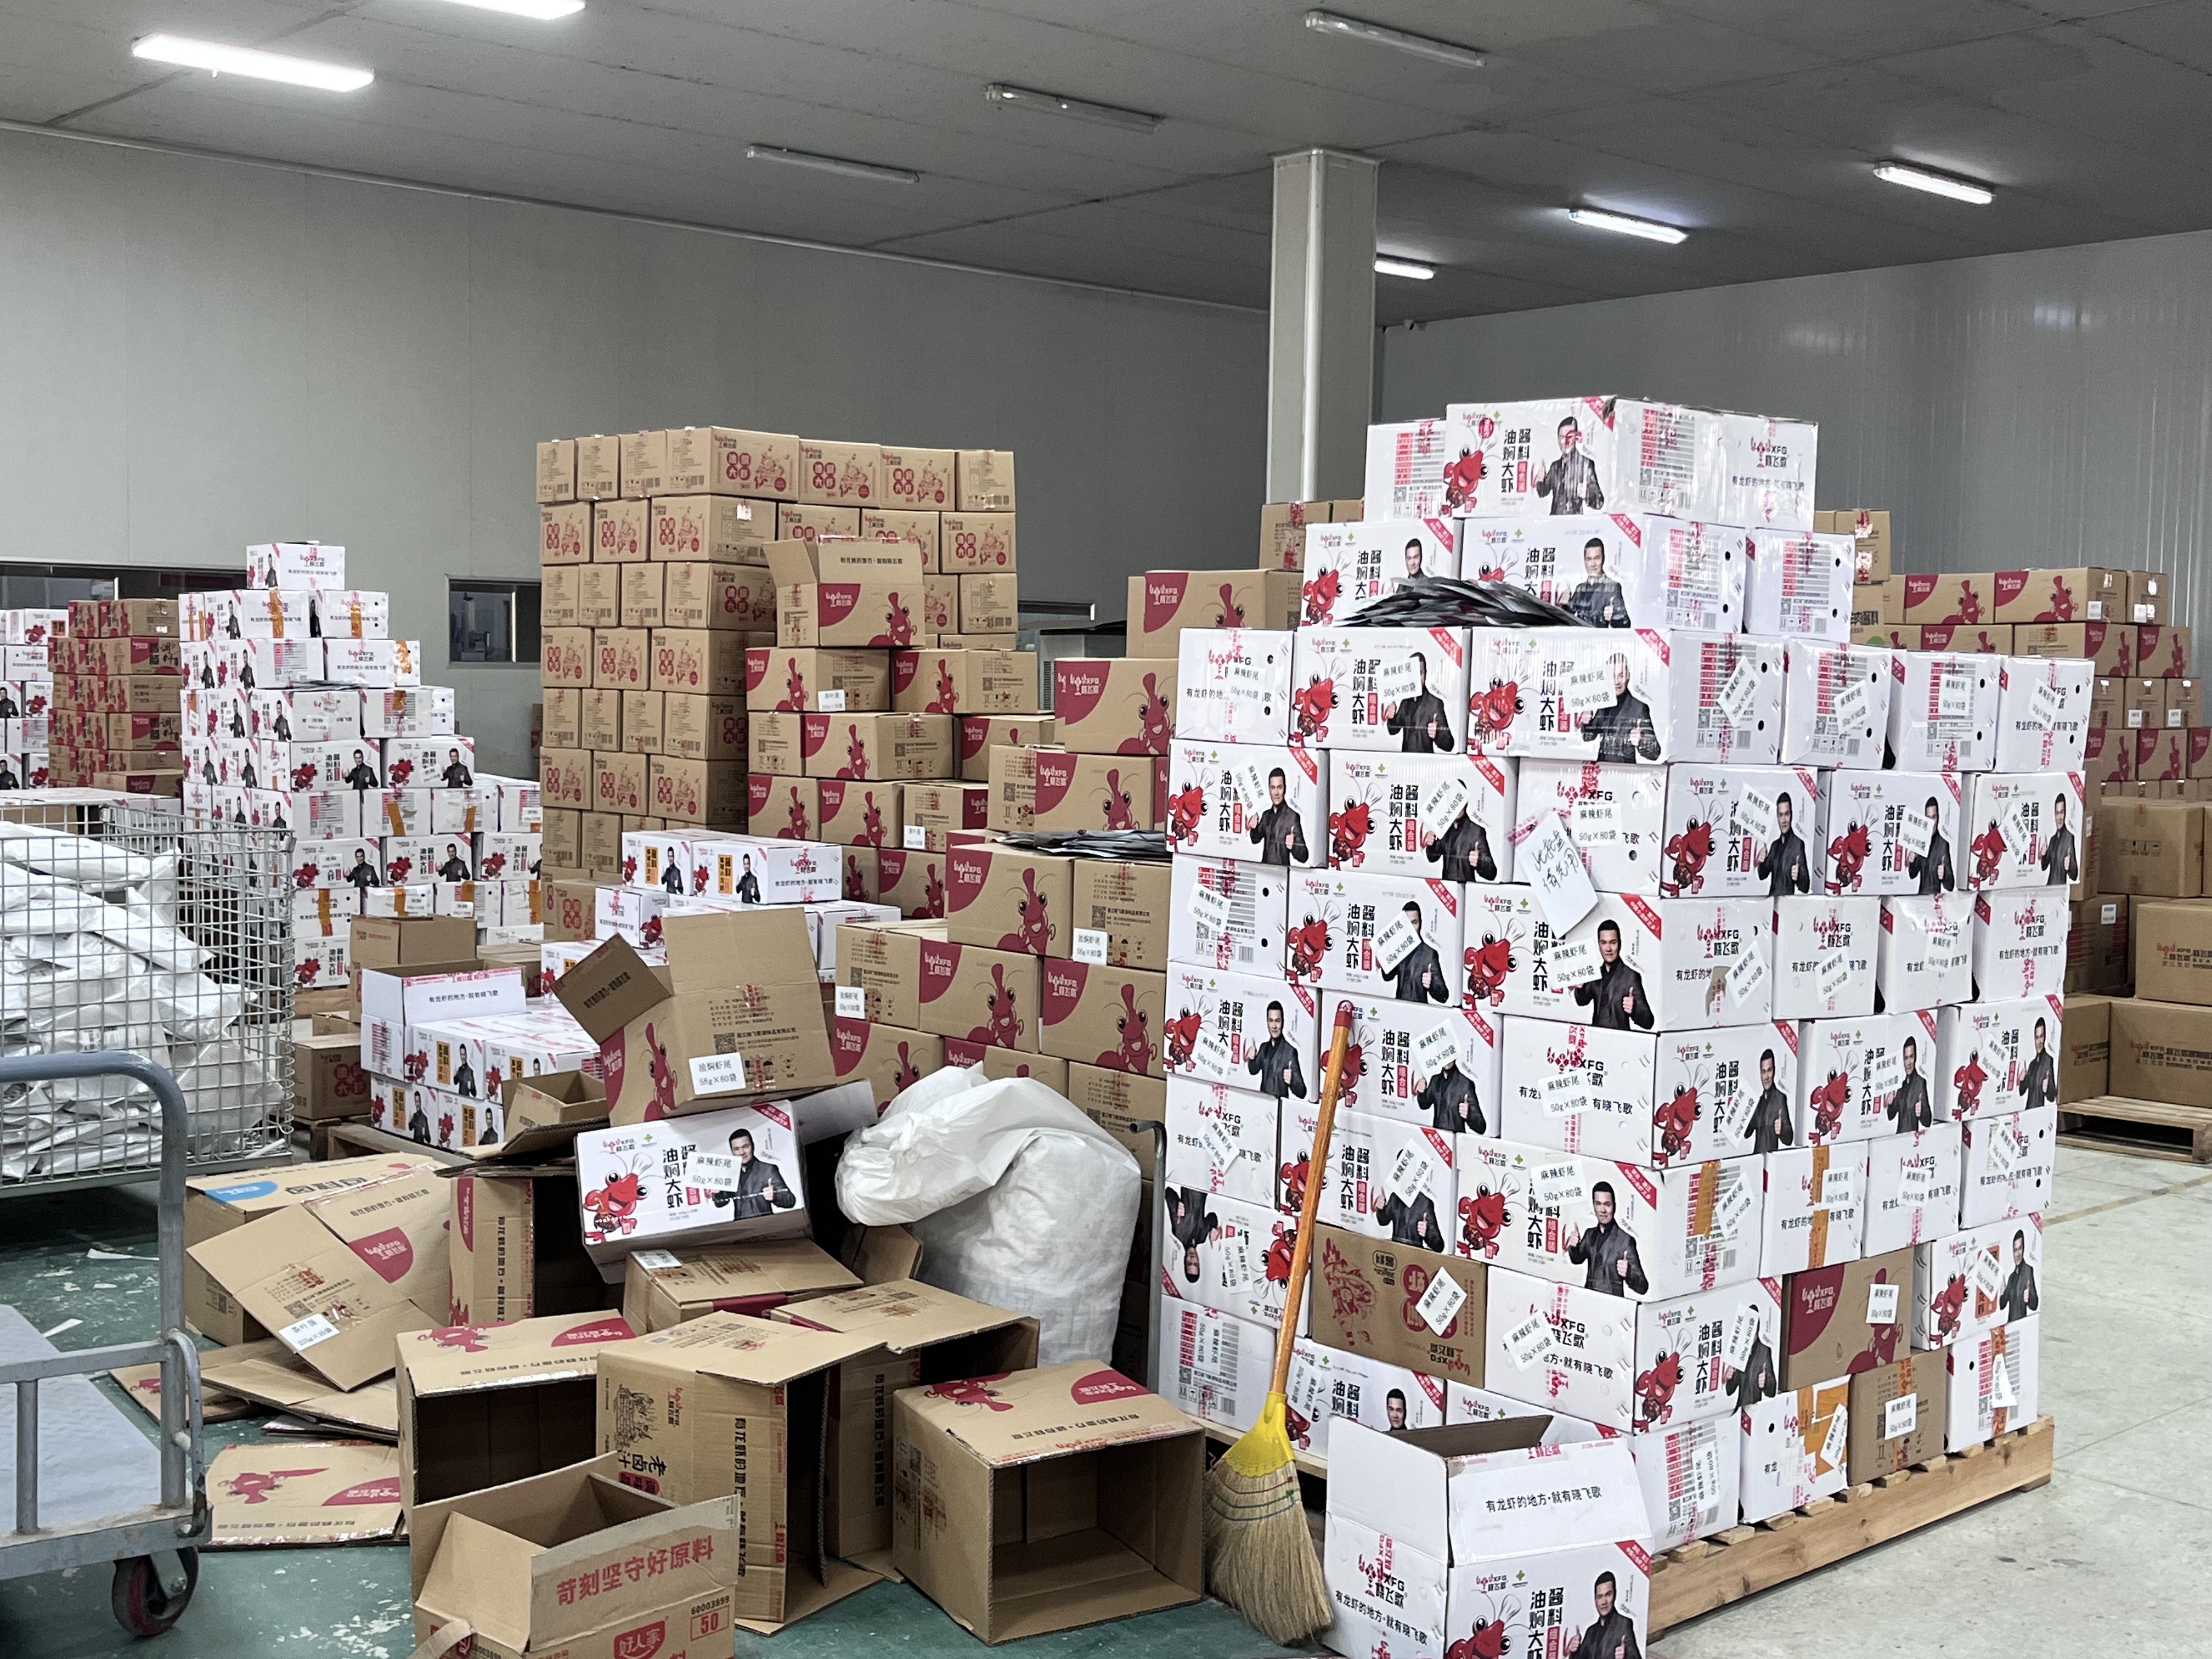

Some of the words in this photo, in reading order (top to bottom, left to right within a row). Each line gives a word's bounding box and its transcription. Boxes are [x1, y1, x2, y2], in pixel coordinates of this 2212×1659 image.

[1502, 428, 1515, 493] 油焖大虾
[1355, 551, 1368, 601] 油焖大
[1525, 548, 1539, 596] 油焖大
[1352, 658, 1366, 724] 油焖大虾
[1220, 770, 1232, 832] 油焖大虾
[1389, 784, 1402, 850] 油焖大虾
[1405, 785, 1419, 818] 酱料
[1346, 904, 1360, 969] 油焖大虾
[1362, 905, 1375, 938] 酱料
[1533, 921, 1549, 992] 油焖大虾
[1218, 1000, 1230, 1047] 油焖大
[1231, 1002, 1243, 1033] 酱料
[1381, 1029, 1395, 1096] 油焖大虾
[1397, 1031, 1410, 1065] 酱料
[1222, 1112, 1241, 1124] XFG
[662, 1148, 684, 1209] 油焖大虾
[1341, 1144, 1355, 1210] 油焖大虾
[1356, 1147, 1370, 1181] 酱料
[1527, 1178, 1543, 1250] 焖大虾
[1695, 1324, 1710, 1395] 油焖大虾
[1711, 1320, 1723, 1356] 酱料
[1486, 1486, 1602, 1513] 有龙虾的地方·就有晓飞歌
[556, 1535, 714, 1606] 苛刻坚守好原料
[691, 1595, 730, 1615] 60003899
[701, 1612, 719, 1634] 50
[1335, 1589, 1427, 1646] 有龙虾的地方·就有晓飞歌
[1548, 1587, 1564, 1626] 酱料
[619, 1628, 661, 1657] 好人家
